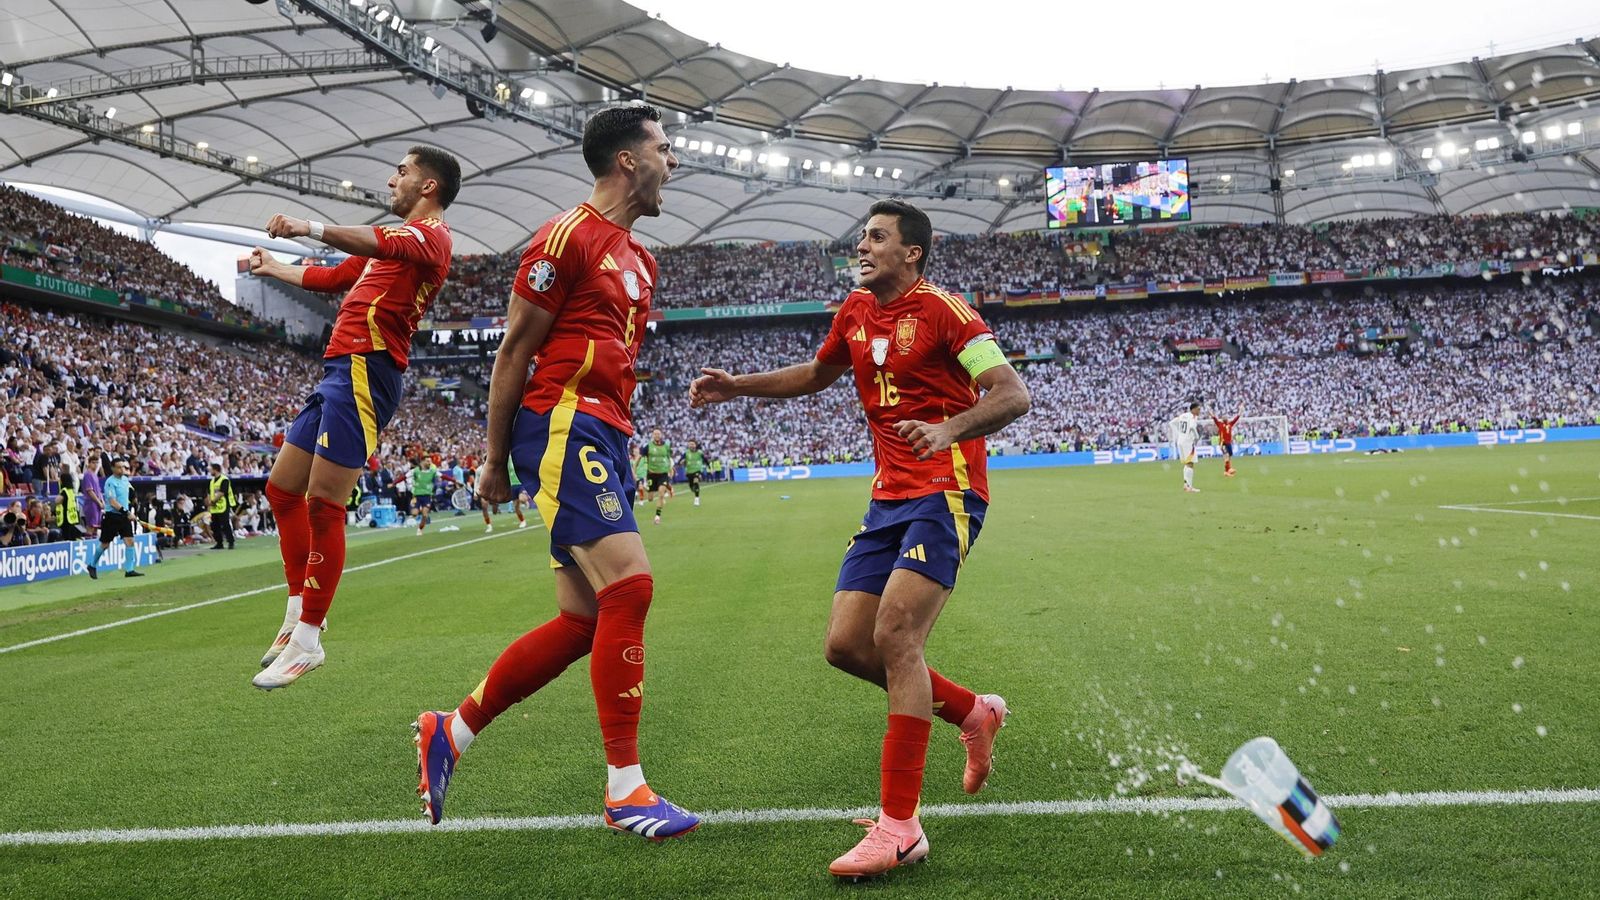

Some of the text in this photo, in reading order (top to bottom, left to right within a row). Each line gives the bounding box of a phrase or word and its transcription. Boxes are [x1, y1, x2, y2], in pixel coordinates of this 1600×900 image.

[35, 274, 93, 298] STUTTGART
[705, 305, 783, 317] STUTTGART
[624, 306, 638, 348] 6
[964, 354, 984, 369] ESPECT
[873, 370, 901, 407] 16
[1477, 428, 1546, 445] BYD
[1289, 439, 1356, 454] BYD
[578, 445, 608, 484] 6
[1094, 449, 1158, 464] BYD
[748, 465, 811, 481] BYD
[0, 549, 69, 581] king.com
